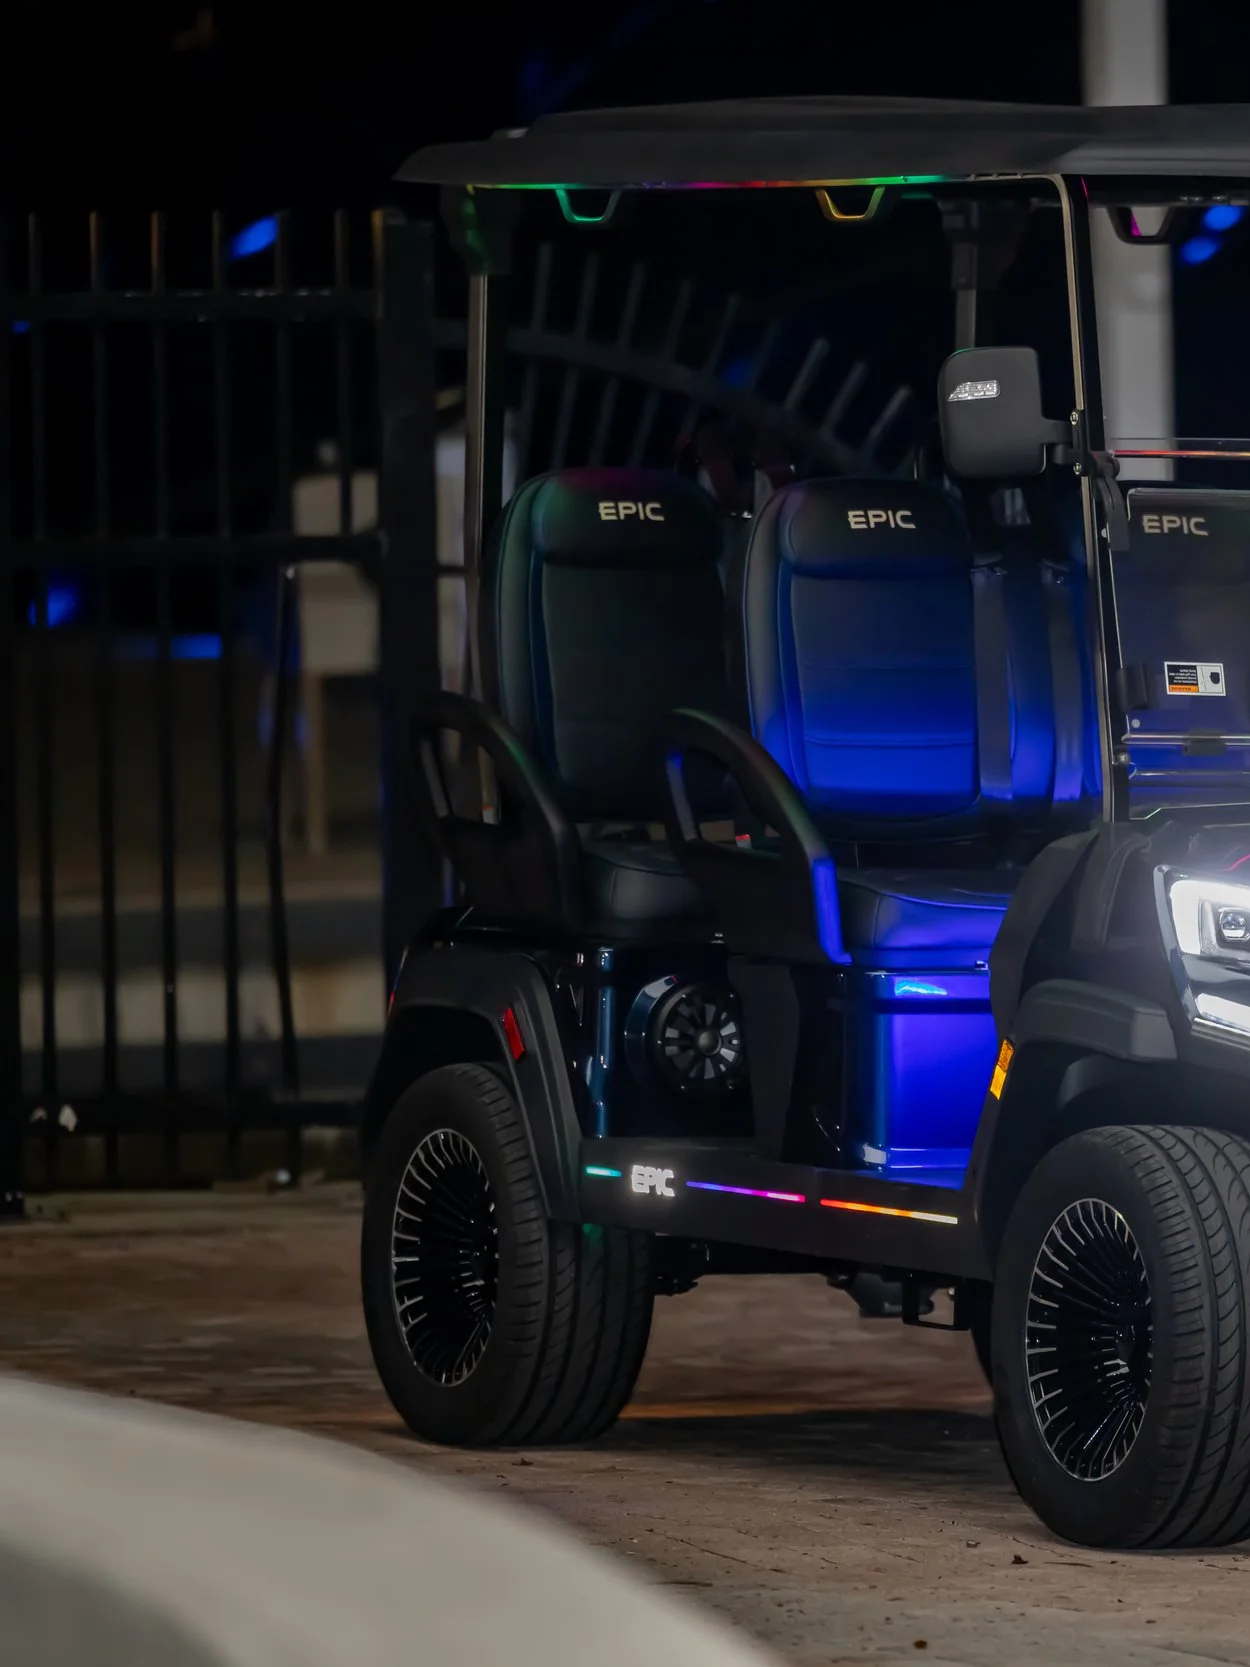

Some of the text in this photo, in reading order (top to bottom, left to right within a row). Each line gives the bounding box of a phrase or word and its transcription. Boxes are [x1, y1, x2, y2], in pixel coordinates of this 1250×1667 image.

[599, 502, 665, 521] EPIC
[847, 510, 917, 529] EPIC
[1142, 515, 1209, 536] EPIC
[631, 1165, 675, 1197] EPIC
